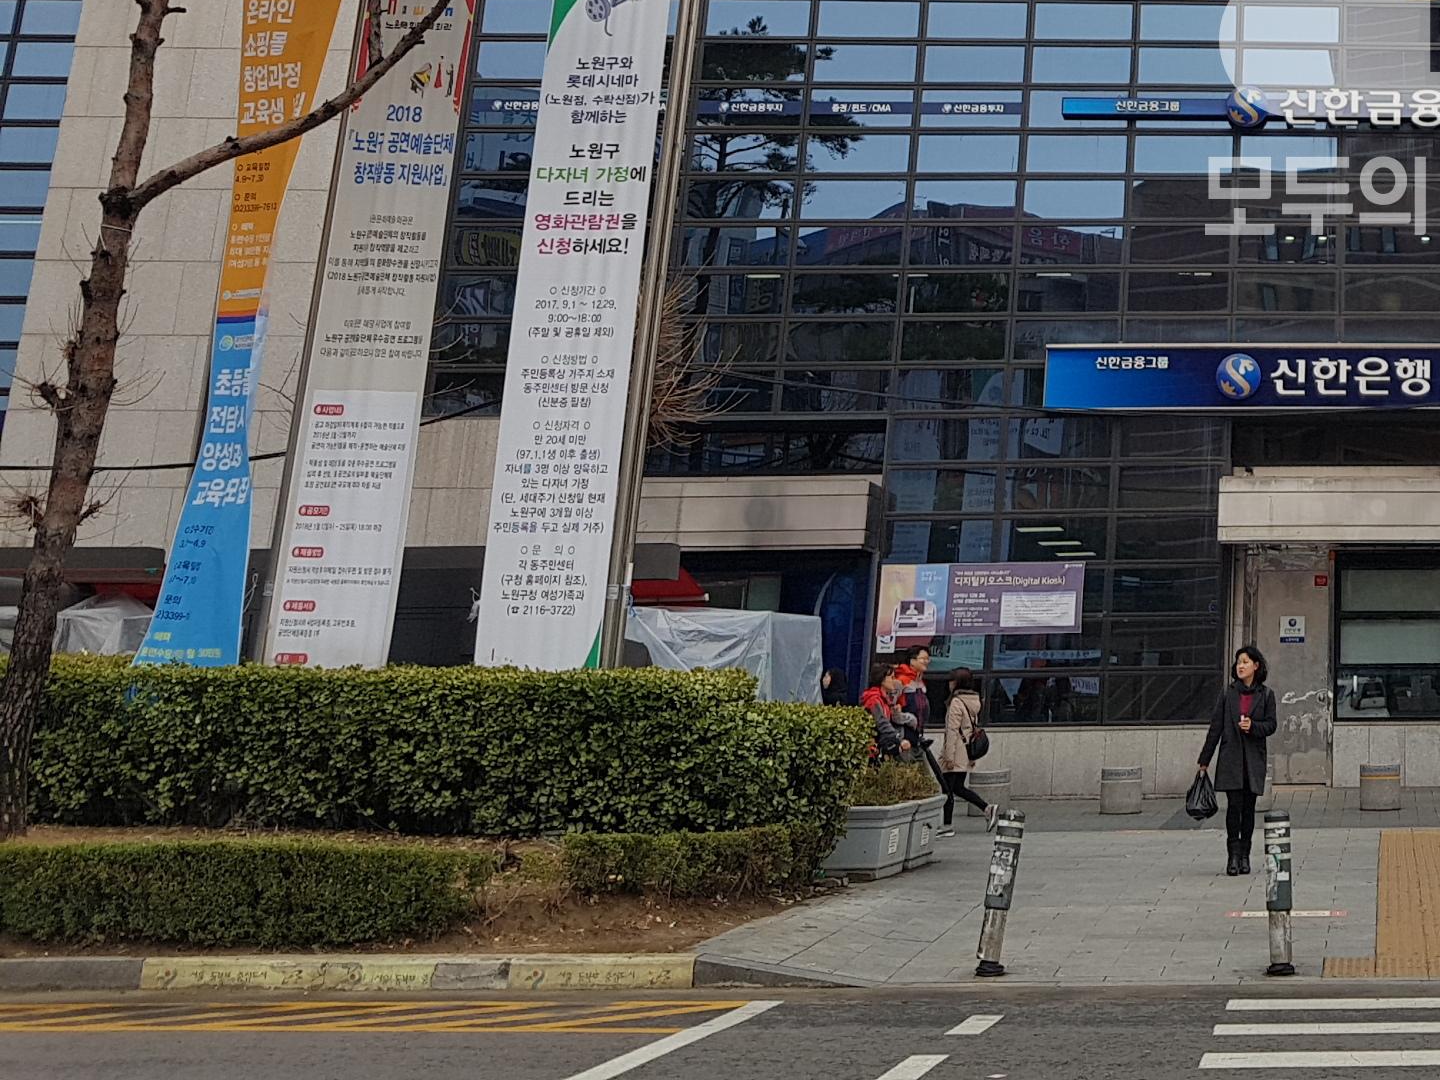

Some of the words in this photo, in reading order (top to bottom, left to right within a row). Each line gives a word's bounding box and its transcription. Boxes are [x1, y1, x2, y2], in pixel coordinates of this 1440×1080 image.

[243, 31, 288, 58] 쇼핑몰
[576, 55, 634, 71] 노원구와
[243, 62, 301, 93] 창업과정
[566, 73, 639, 89] 롯데시네마
[544, 92, 587, 106] (노원점,
[592, 91, 655, 106] 수락산점)가
[240, 96, 285, 126] 교육생
[731, 102, 783, 113] 신한금융투자
[831, 102, 892, 113] 증권/펀드/CMA
[953, 103, 1004, 114] 신한금융투자
[1115, 99, 1180, 113] 신한금융그룹
[386, 104, 422, 123] 2018
[571, 109, 627, 125] 함께하는
[388, 131, 454, 155] 공연예술단체
[569, 142, 620, 160] 노원구
[536, 166, 589, 184] 다자녀
[595, 165, 646, 184] 가정에
[563, 189, 615, 207] 드리는
[534, 212, 638, 231] 영화관람권을
[537, 237, 629, 256] 신청하세요!
[561, 286, 596, 296] 신청기간
[535, 299, 560, 310] 2017.
[547, 313, 602, 323] 9:00~18:00
[528, 327, 549, 338] (주말
[565, 327, 591, 338] 공휴일
[593, 327, 615, 338] 제외)
[552, 355, 587, 366] 신청방법
[1095, 355, 1169, 370] 신한금융그룹
[520, 369, 565, 380] 주민등록상
[568, 369, 594, 380] 거주지
[596, 369, 615, 380] 소재
[1270, 357, 1432, 397] 신한은행
[523, 383, 568, 394] 동주민센터
[570, 383, 588, 394] 방문
[591, 383, 609, 394] 신청
[538, 397, 567, 408] (신분증
[544, 420, 579, 431] 신청자격
[546, 435, 565, 445] 20세
[568, 435, 586, 445] 미만
[559, 449, 577, 460] 이후
[580, 449, 601, 460] 출생)
[504, 463, 532, 474] 자녀를
[534, 463, 549, 474] 3명
[553, 463, 570, 474] 이상
[573, 463, 608, 474] 양육하고
[521, 478, 539, 488] 있는
[542, 478, 569, 489] 다자녀
[572, 478, 589, 489] 가정
[192, 476, 249, 508] 교육모집
[519, 493, 555, 504] 세대주가
[558, 493, 584, 504] 신청일
[587, 493, 606, 504] 현재
[510, 508, 547, 519] 노원구에
[550, 508, 573, 519] 3개월
[575, 508, 593, 519] 이상
[493, 522, 537, 534] 주민등록을
[541, 522, 558, 533] 두고
[561, 522, 580, 533] 실제
[582, 522, 605, 534] 거주)
[530, 560, 575, 571] 동주민센터
[501, 575, 523, 586] (구청
[525, 575, 561, 586] 홈페이지
[501, 589, 537, 601] 노원구청
[541, 589, 584, 601] 여성가족과
[522, 605, 576, 617] 2116-3722)
